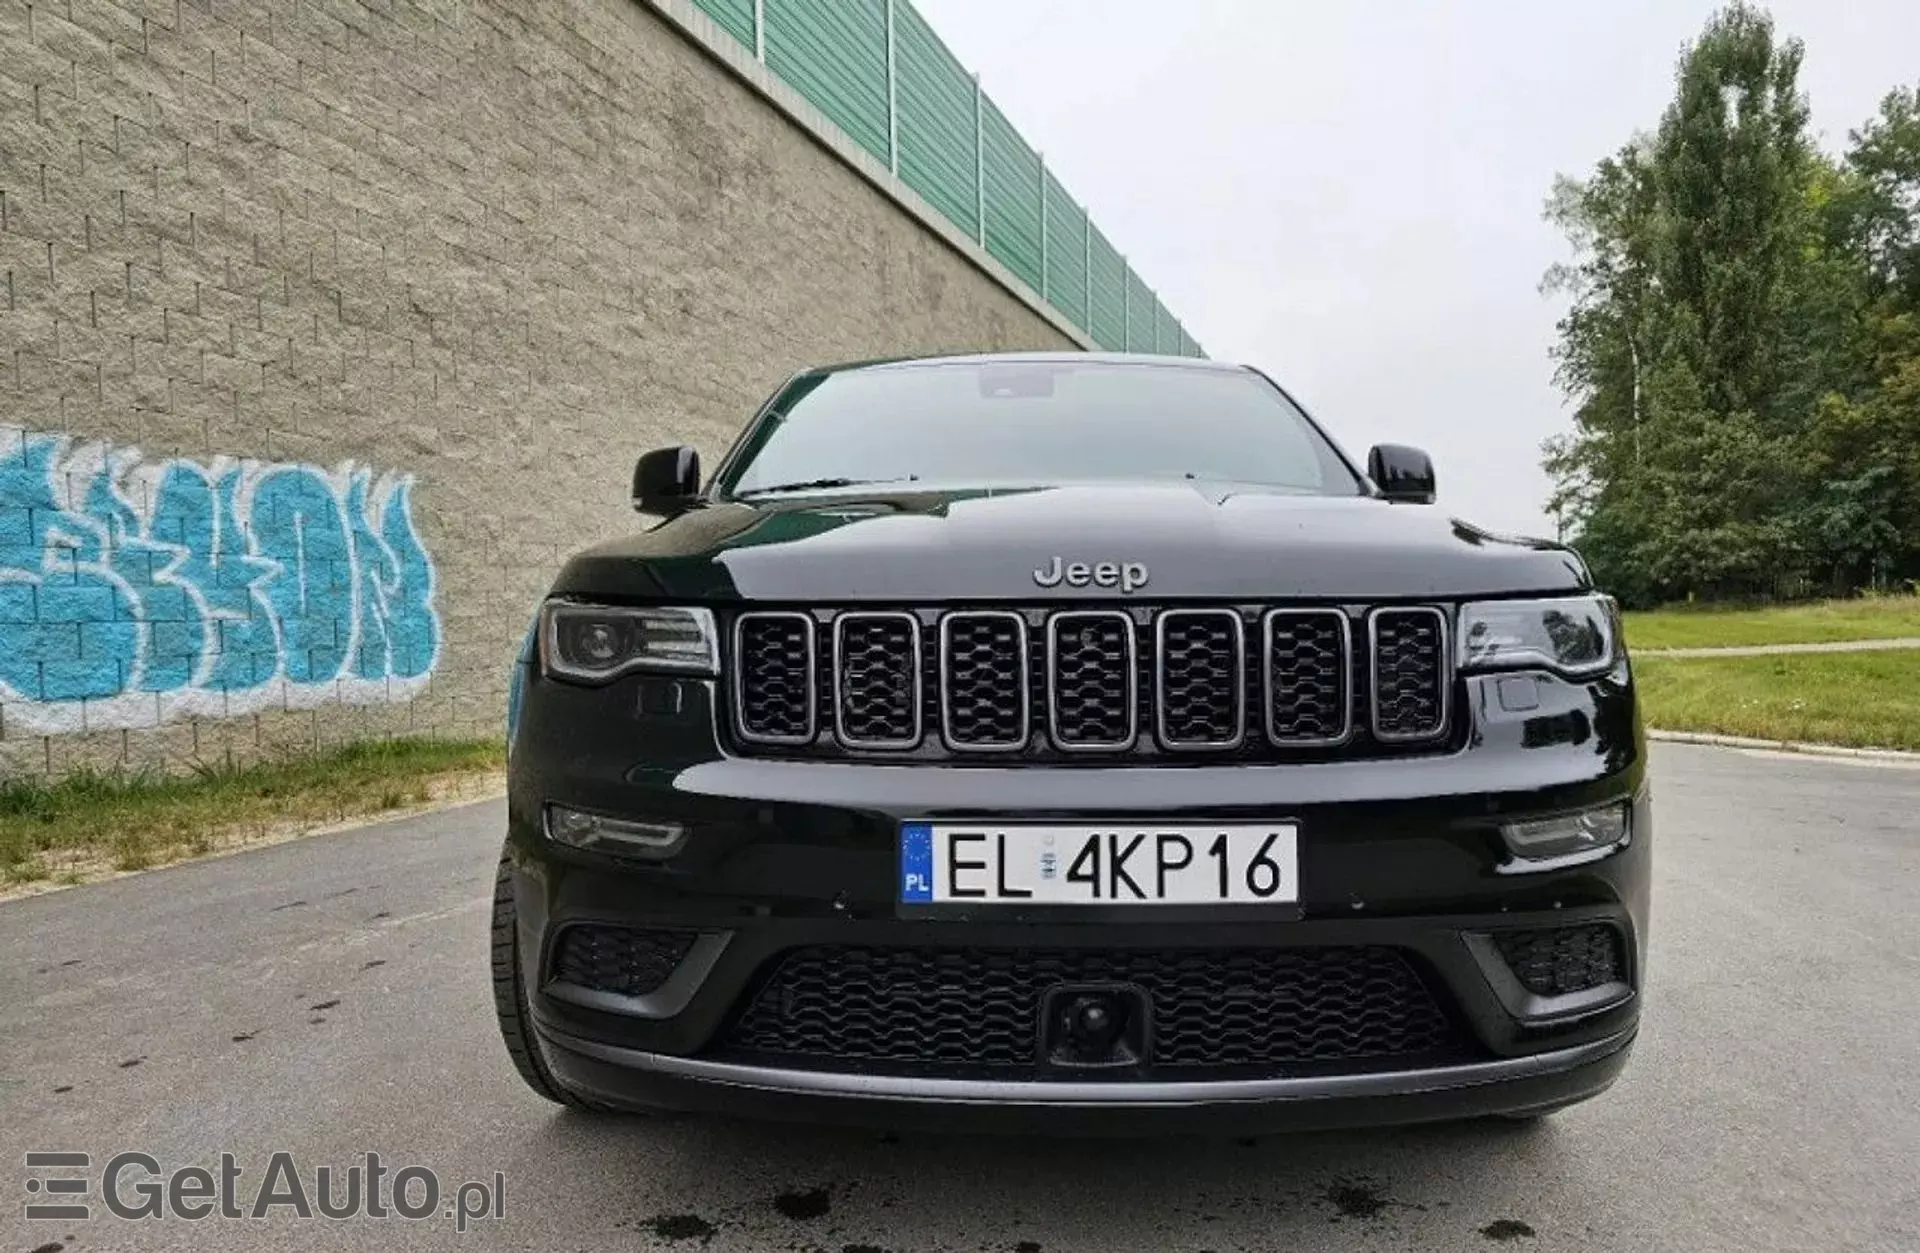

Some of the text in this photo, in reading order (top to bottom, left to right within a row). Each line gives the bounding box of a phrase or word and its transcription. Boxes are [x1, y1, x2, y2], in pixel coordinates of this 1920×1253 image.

[1033, 556, 1149, 593] Jeep
[904, 873, 929, 891] PL
[948, 833, 1281, 898] EL 4KP16
